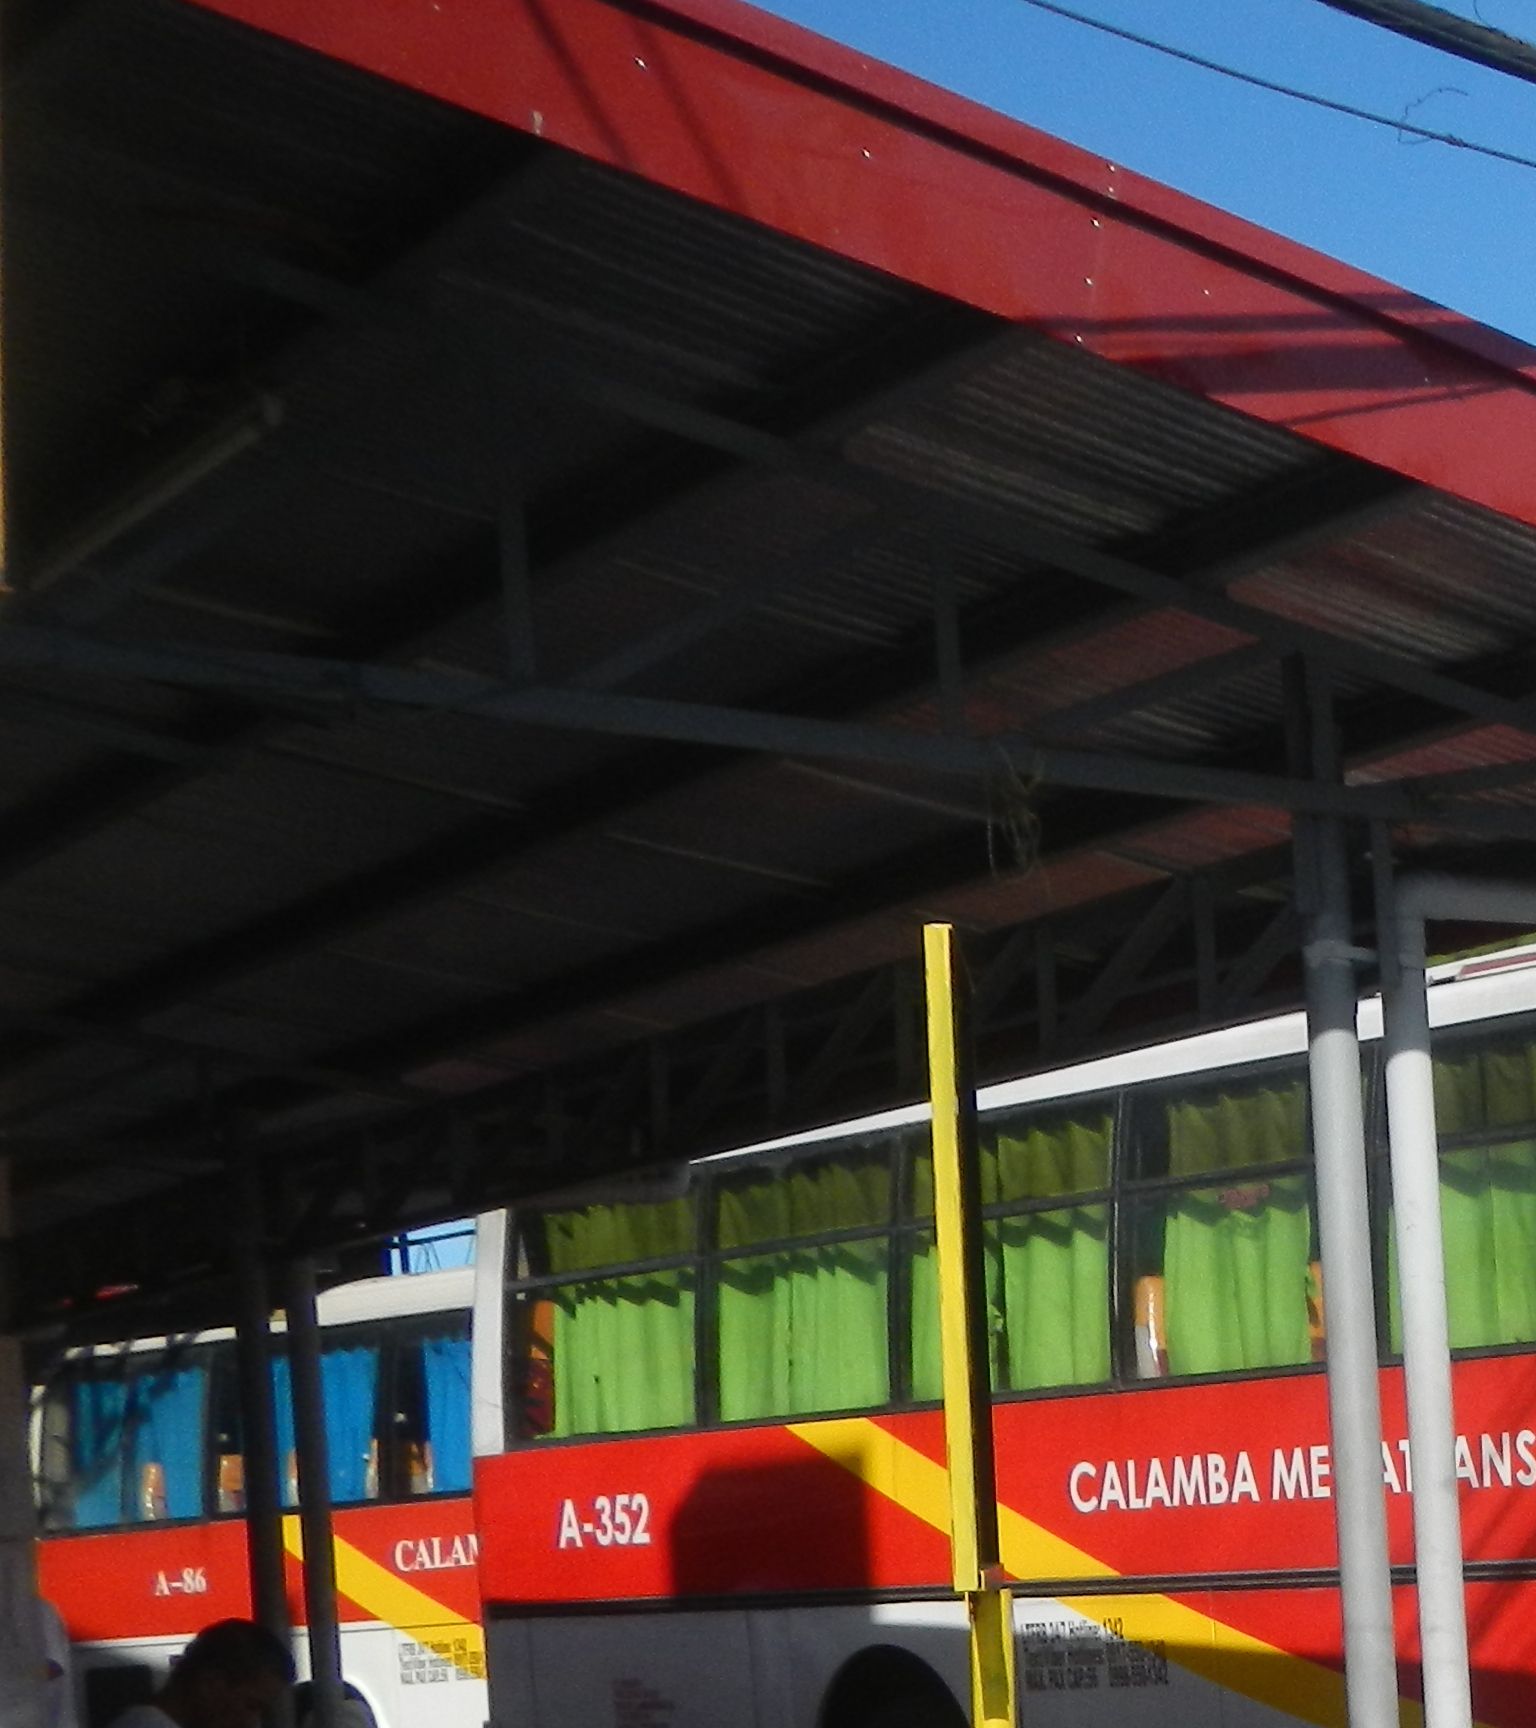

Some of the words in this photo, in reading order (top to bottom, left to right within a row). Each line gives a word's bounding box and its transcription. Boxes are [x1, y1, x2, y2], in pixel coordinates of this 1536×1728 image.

[1069, 1449, 1261, 1514] CALAMBA
[558, 1492, 651, 1549] A-352
[154, 1567, 207, 1597] A-86
